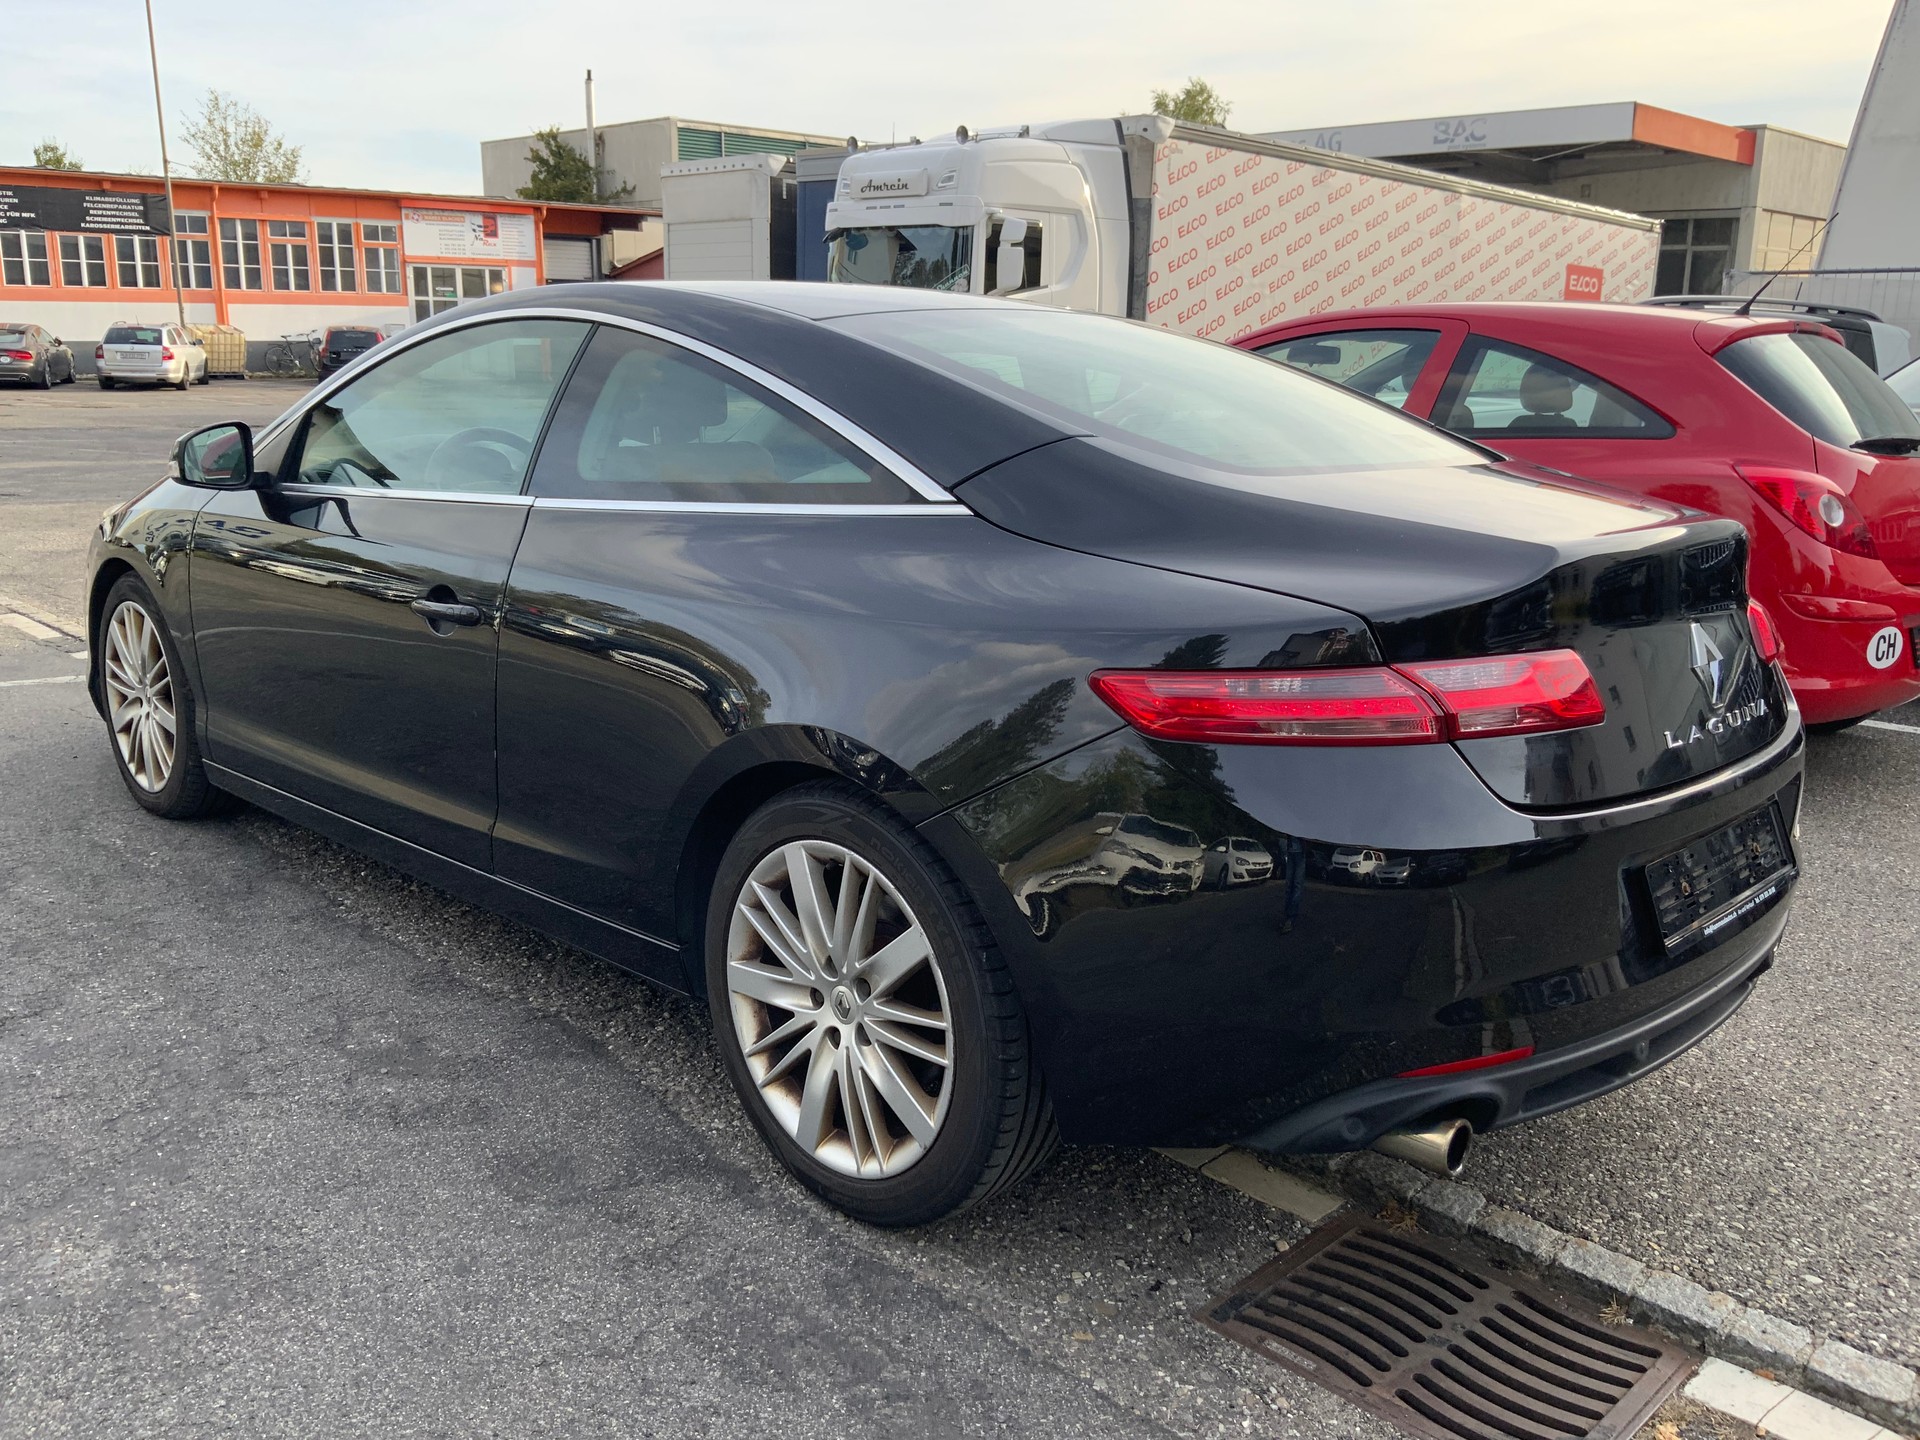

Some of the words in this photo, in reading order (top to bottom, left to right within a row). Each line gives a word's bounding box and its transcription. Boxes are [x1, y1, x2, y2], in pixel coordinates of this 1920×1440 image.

[1315, 131, 1342, 152] AG
[1434, 118, 1487, 144] BAC
[1154, 141, 1179, 164] LCO
[1168, 160, 1198, 185] ELCO
[1234, 153, 1261, 176] ELCO
[1196, 173, 1227, 199] ELCO
[1252, 172, 1279, 195] ELCO
[1328, 183, 1352, 204] ELCO
[1215, 192, 1244, 217] ELCO
[1278, 184, 1304, 207] ELCO
[1350, 194, 1375, 216] ELCO
[1395, 192, 1417, 213] ELCO
[1157, 196, 1188, 221] ELCO
[1242, 204, 1270, 229] ELCO
[1294, 203, 1319, 224] ELCO
[1416, 204, 1438, 224] ELCO
[1456, 202, 1476, 221] ELCO
[1178, 214, 1206, 238] ELCO
[1318, 212, 1344, 235] ELCO
[1365, 210, 1388, 232] ELCO
[1429, 219, 1451, 239] ELCO
[1475, 212, 1494, 231] ELCO
[1206, 226, 1236, 250] ELCO
[1260, 220, 1288, 246] ELCO
[1334, 228, 1360, 250] ELCO
[1388, 222, 1410, 243] ELCO
[1449, 229, 1470, 249] ELCO
[1224, 243, 1253, 268] ELCO
[1286, 234, 1312, 256] ELCO
[1356, 240, 1380, 262] ELCO
[1401, 237, 1423, 258] ELCO
[1461, 244, 1481, 264] ELCO
[1168, 248, 1198, 272] ELCO
[1250, 252, 1278, 277] ELCO
[1302, 250, 1328, 272] ELCO
[1370, 256, 1395, 277] ELCO
[1421, 247, 1443, 267] ELCO
[1480, 253, 1499, 273] ELCO
[1187, 264, 1216, 289] ELCO
[1268, 269, 1294, 292] ELCO
[1325, 261, 1350, 282] ELCO
[1392, 265, 1415, 286] ELCO
[1434, 262, 1456, 282] ELCO
[1454, 271, 1474, 291] ELCO
[1216, 276, 1244, 301] ELCO
[1292, 280, 1318, 304] ELCO
[1340, 276, 1365, 297] ELCO
[1407, 280, 1428, 301] ELCO
[1466, 284, 1486, 302] ELCO
[1521, 288, 1537, 301] LCO
[1569, 275, 1598, 292] ELCO
[1147, 288, 1178, 314] ELCO
[1232, 292, 1261, 318] ELCO
[1364, 284, 1386, 306] ELCO
[1427, 290, 1448, 303] LCO
[1178, 299, 1207, 325] ELCO
[1260, 302, 1286, 326] ELCO
[1196, 314, 1225, 338] ELCO
[1225, 324, 1252, 343] LCO
[1875, 632, 1896, 662] CH
[1664, 698, 1768, 748] LAGUNA
